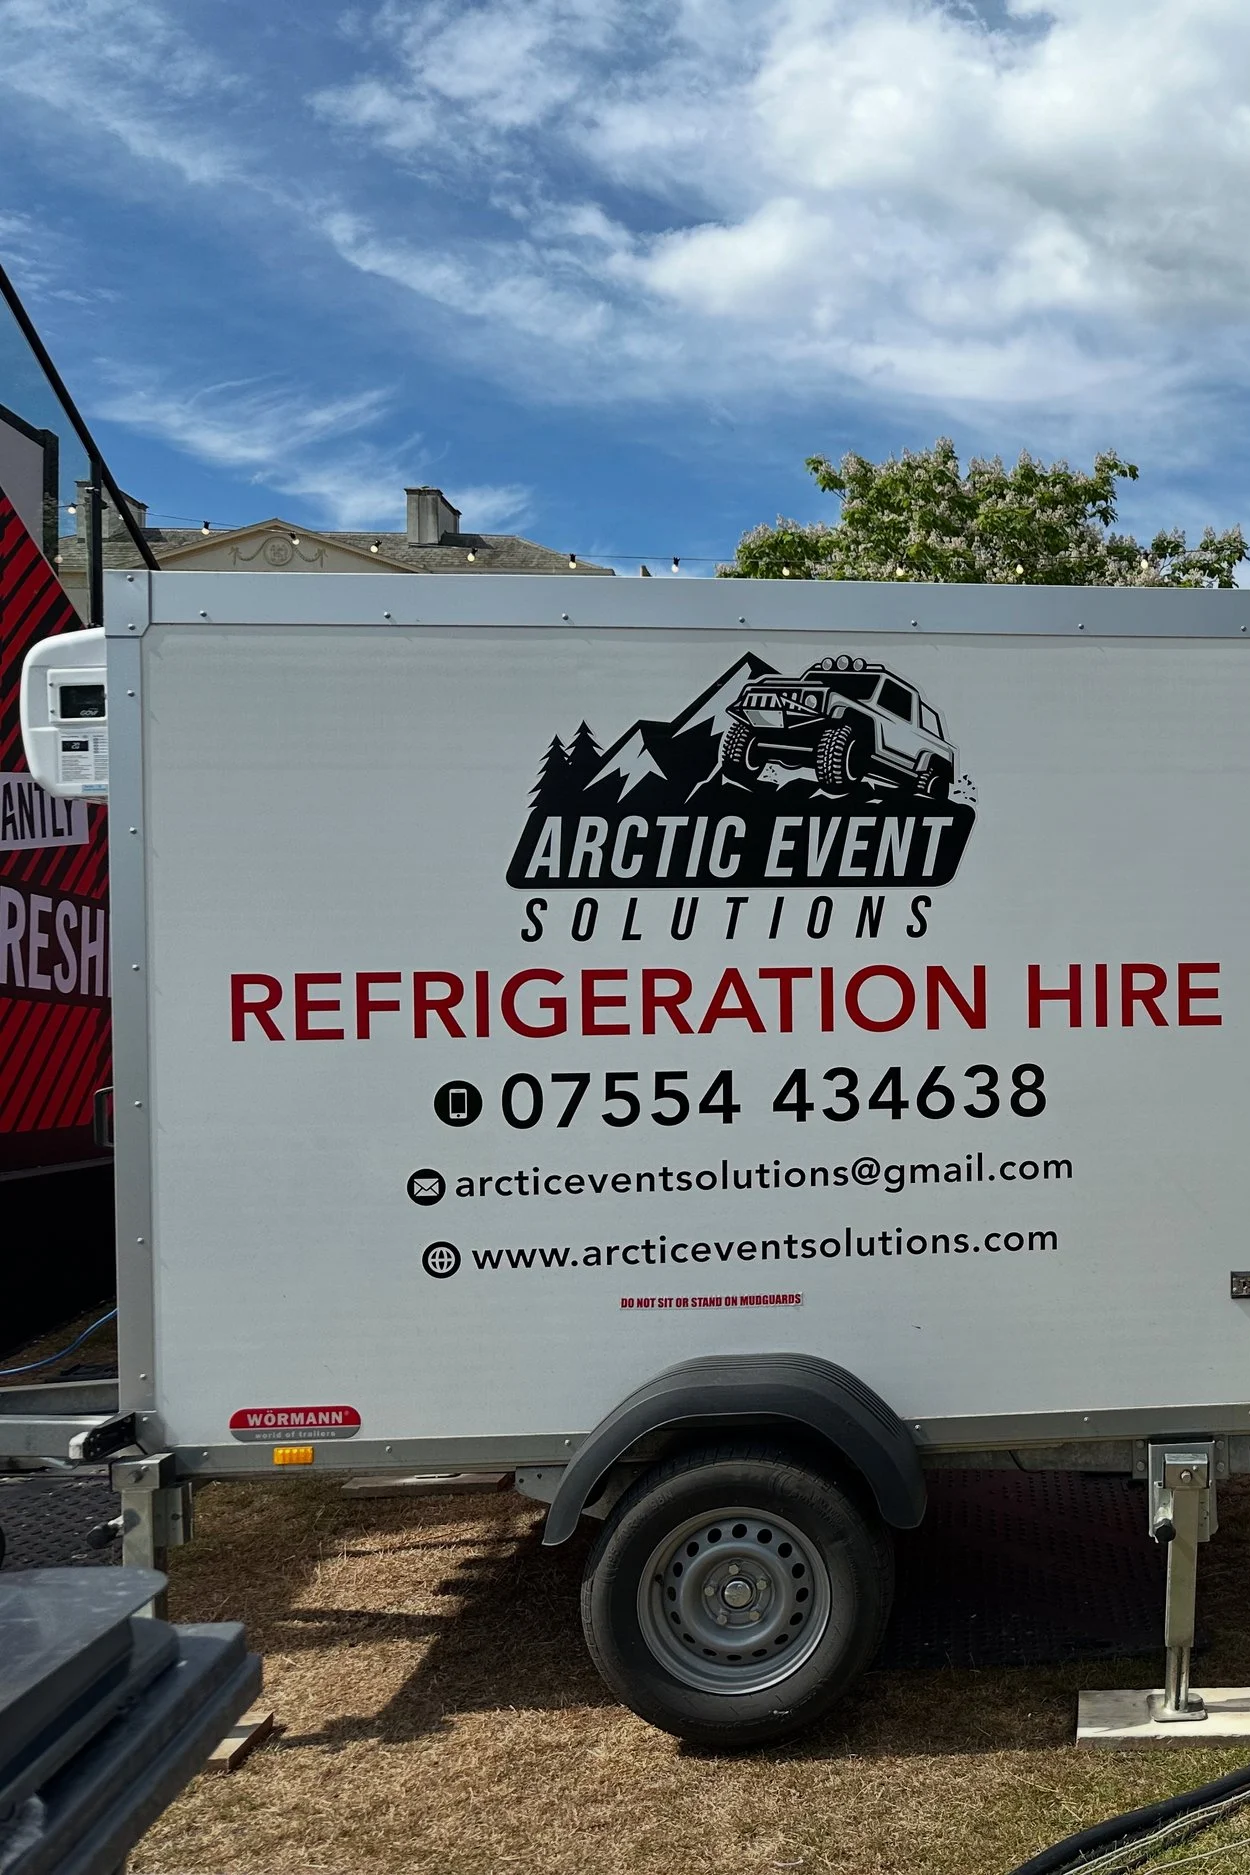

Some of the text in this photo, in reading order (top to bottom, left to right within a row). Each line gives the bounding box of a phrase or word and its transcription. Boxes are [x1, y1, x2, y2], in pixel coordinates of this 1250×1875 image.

[1, 781, 73, 841] ANTLY
[524, 816, 953, 879] ARCTIC EVENT
[0, 885, 112, 998] RESH
[521, 895, 932, 943] SOLUTIONS
[230, 962, 1223, 1041] REFRIGERATION HIRE
[500, 1062, 1047, 1129] 07554 434638
[455, 1152, 1074, 1196] arcticeventsolutions@gmail.com
[472, 1226, 1059, 1270] www.arcticeventsolutions.com
[621, 1294, 801, 1308] DO NOT SIT OR STAND ON MUDGUARDS
[247, 1410, 343, 1427] WÖRMANN
[299, 1430, 336, 1438] trailers
